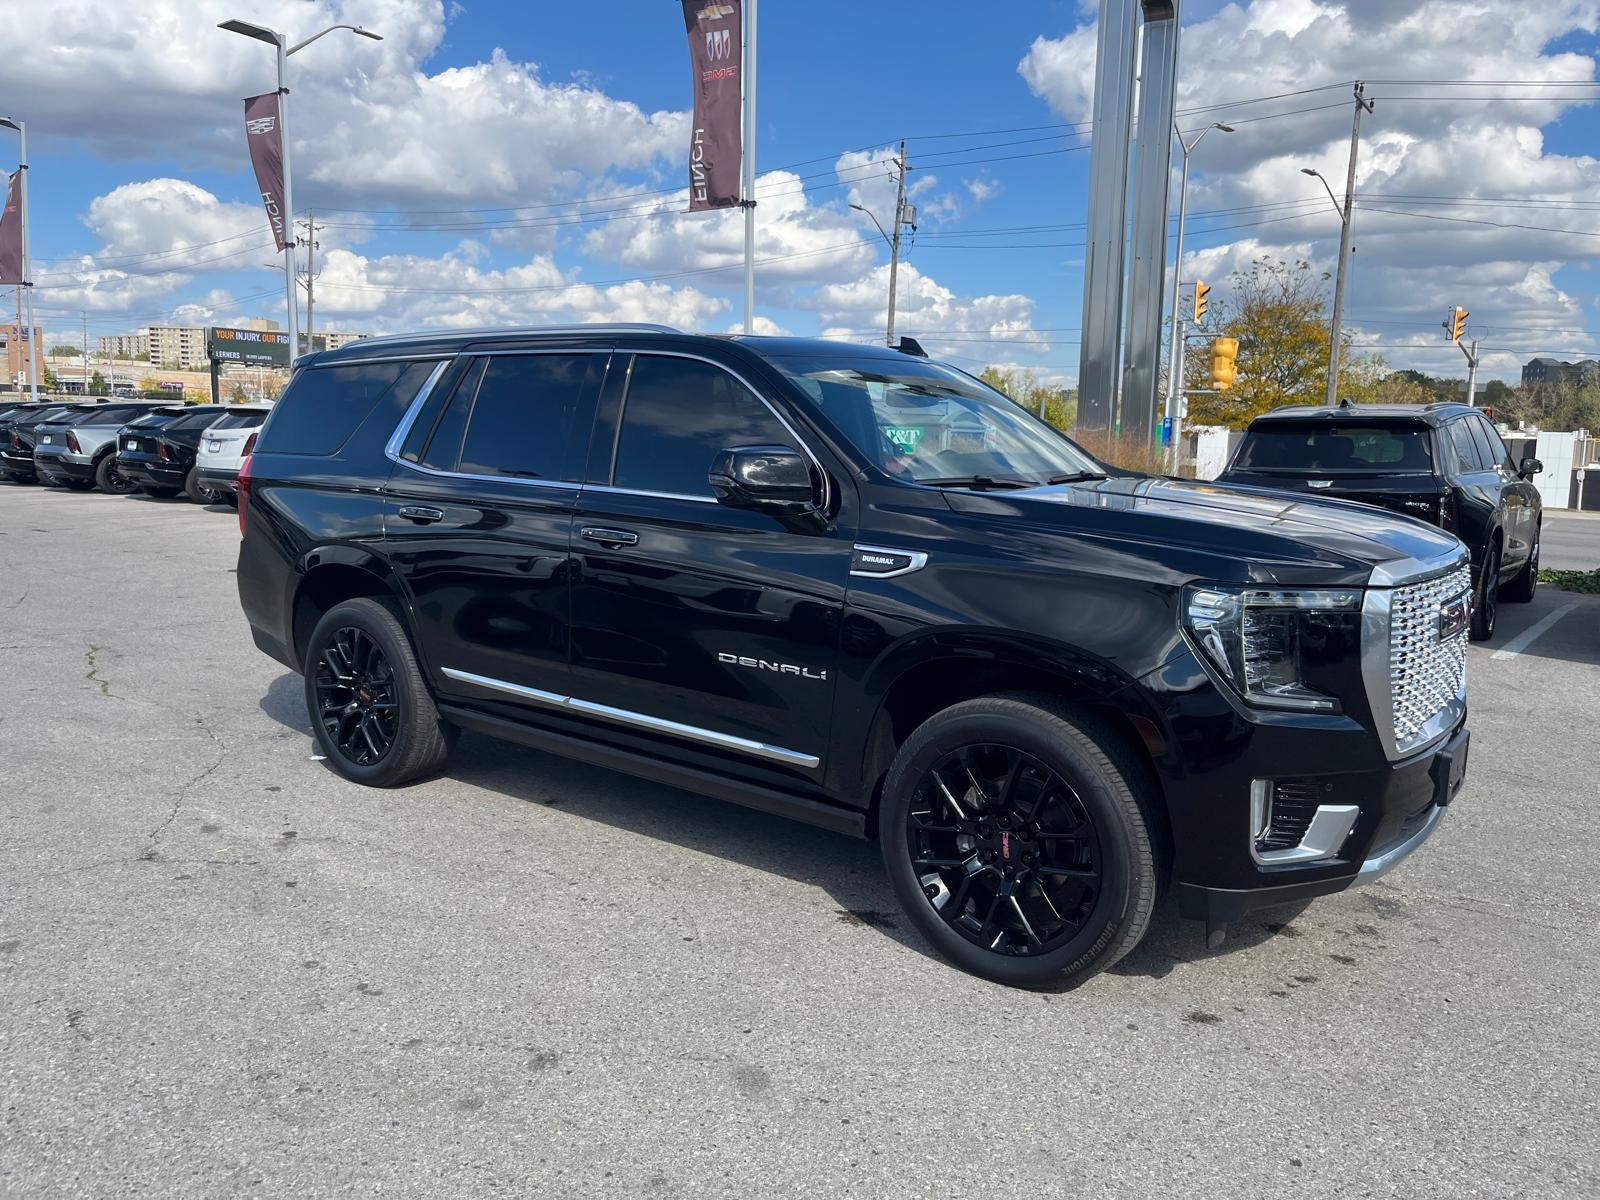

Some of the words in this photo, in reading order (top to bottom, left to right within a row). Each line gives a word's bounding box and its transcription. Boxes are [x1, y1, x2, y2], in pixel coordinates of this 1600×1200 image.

[216, 329, 235, 340] YOUR
[262, 334, 276, 344] OUR
[215, 351, 241, 359] LERNERS
[862, 555, 894, 565] DURAMAX
[718, 652, 827, 681] DENALI
[1002, 832, 1010, 858] GMC
